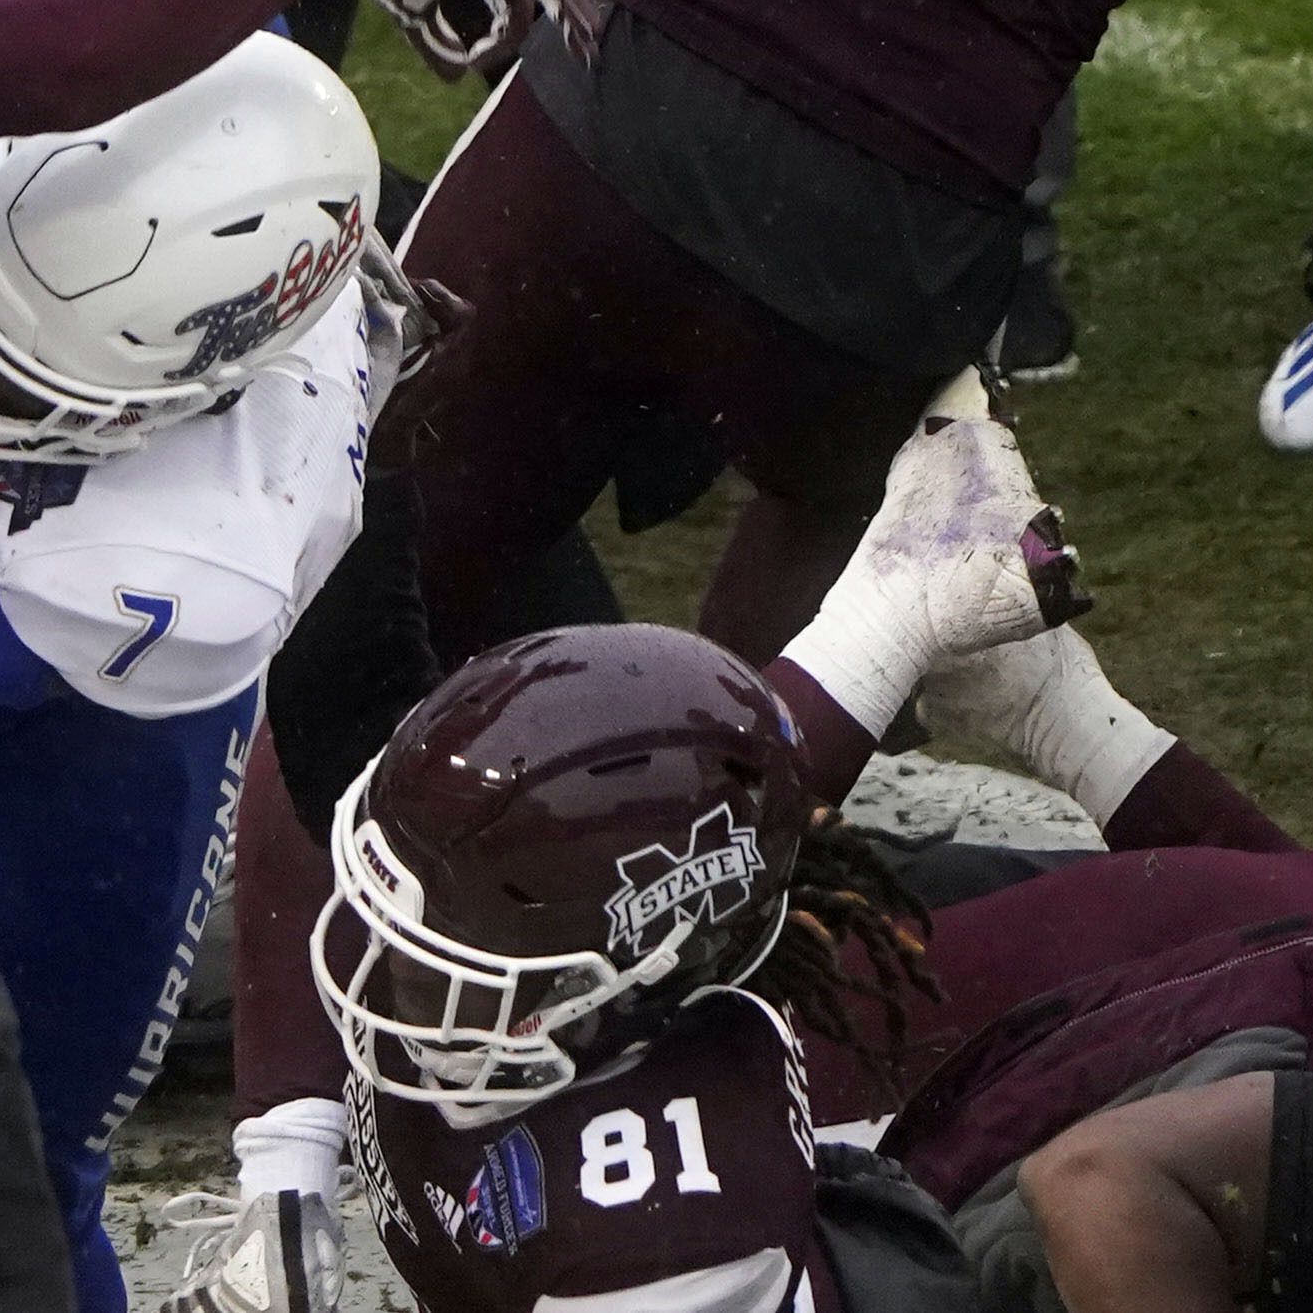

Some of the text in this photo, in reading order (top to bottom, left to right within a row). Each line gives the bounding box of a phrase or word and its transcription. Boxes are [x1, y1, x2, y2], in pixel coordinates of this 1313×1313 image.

[99, 586, 180, 684] 7
[362, 839, 401, 893] STATE
[639, 851, 737, 919] STATE
[580, 1096, 722, 1208] 81
